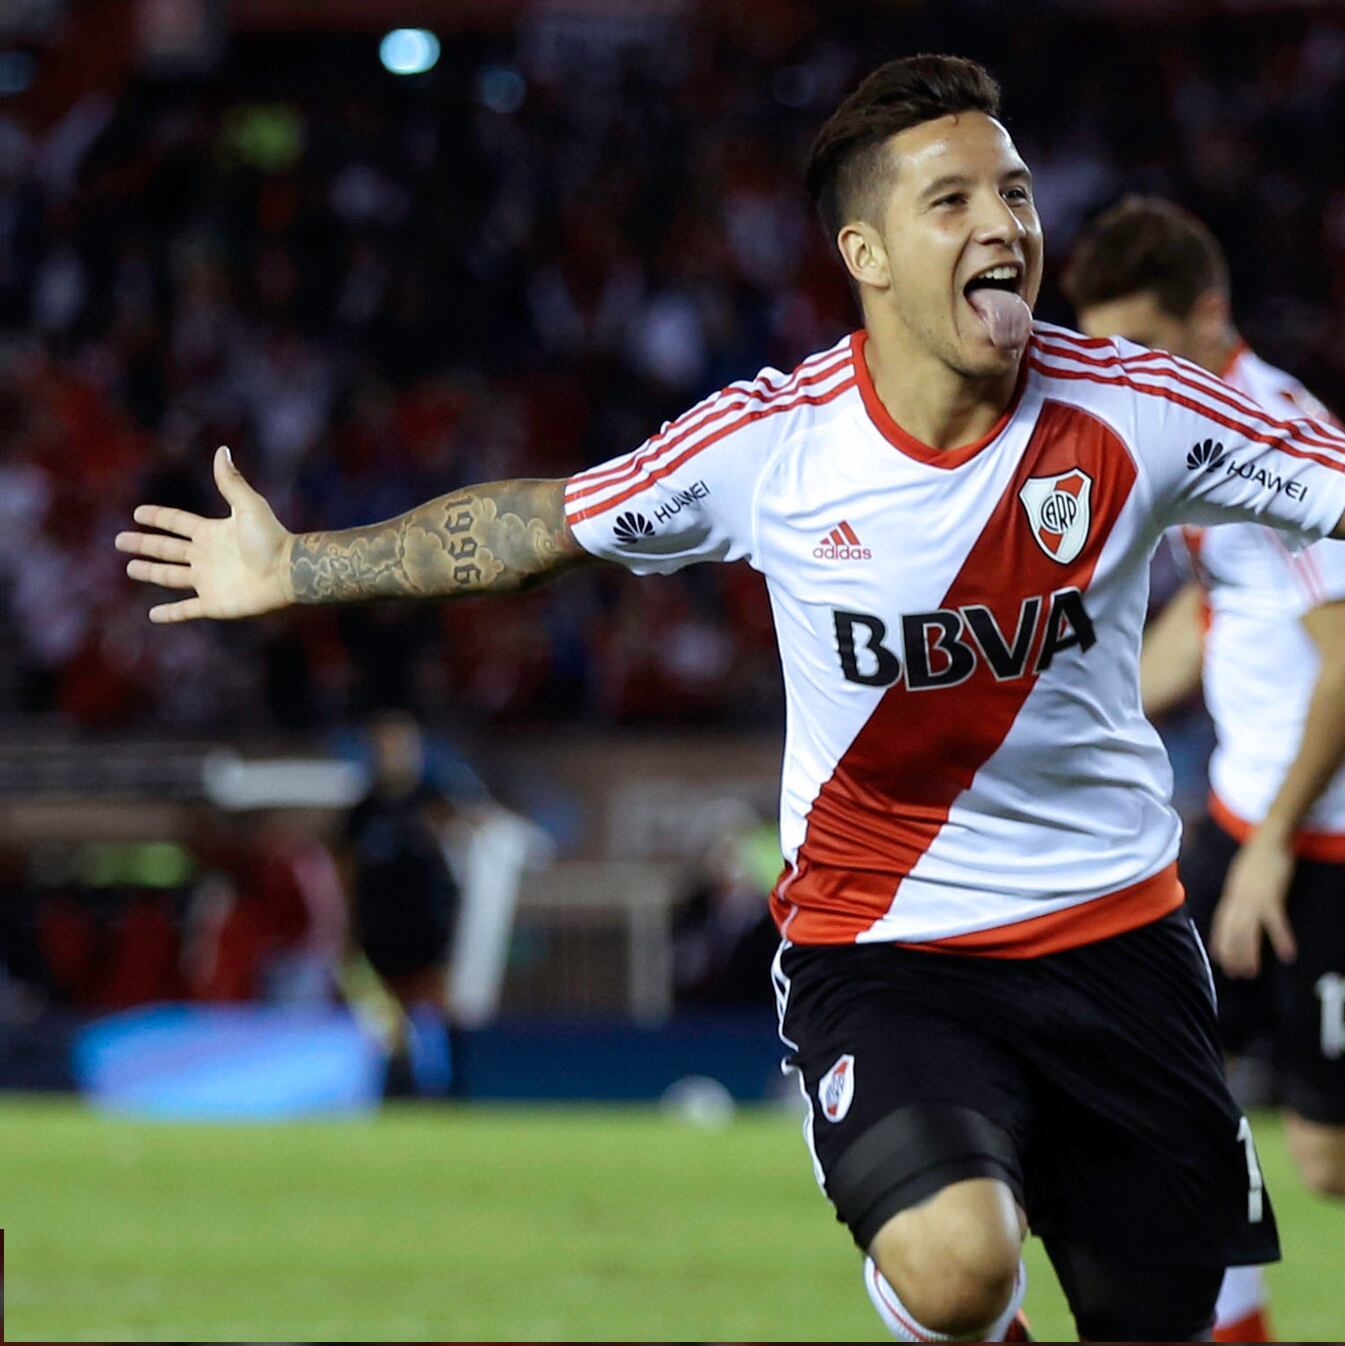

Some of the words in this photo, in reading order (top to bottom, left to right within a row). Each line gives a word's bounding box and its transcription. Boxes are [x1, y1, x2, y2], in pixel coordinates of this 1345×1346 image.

[654, 480, 711, 524] HUAWEI
[1226, 460, 1309, 503] HUAWEI
[813, 545, 872, 560] adidas
[833, 586, 1098, 691] BBVA
